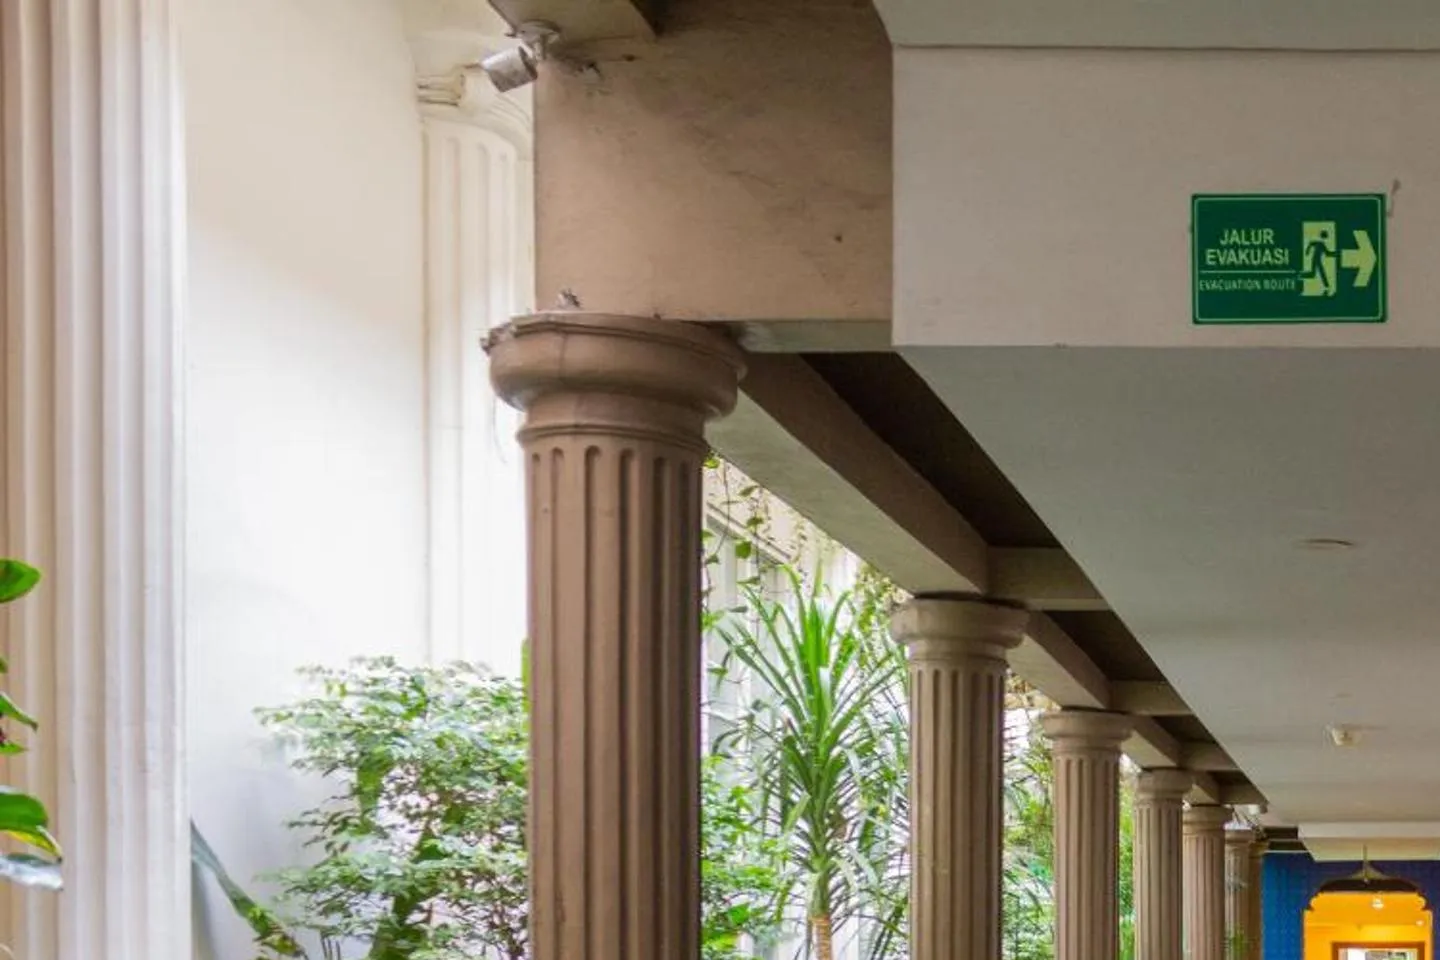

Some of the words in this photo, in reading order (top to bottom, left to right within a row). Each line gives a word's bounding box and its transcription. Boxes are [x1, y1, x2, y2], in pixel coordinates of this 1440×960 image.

[1219, 228, 1275, 246] JALUR
[1206, 248, 1290, 266] EVAKUASI
[1199, 279, 1261, 291] EVACUATION
